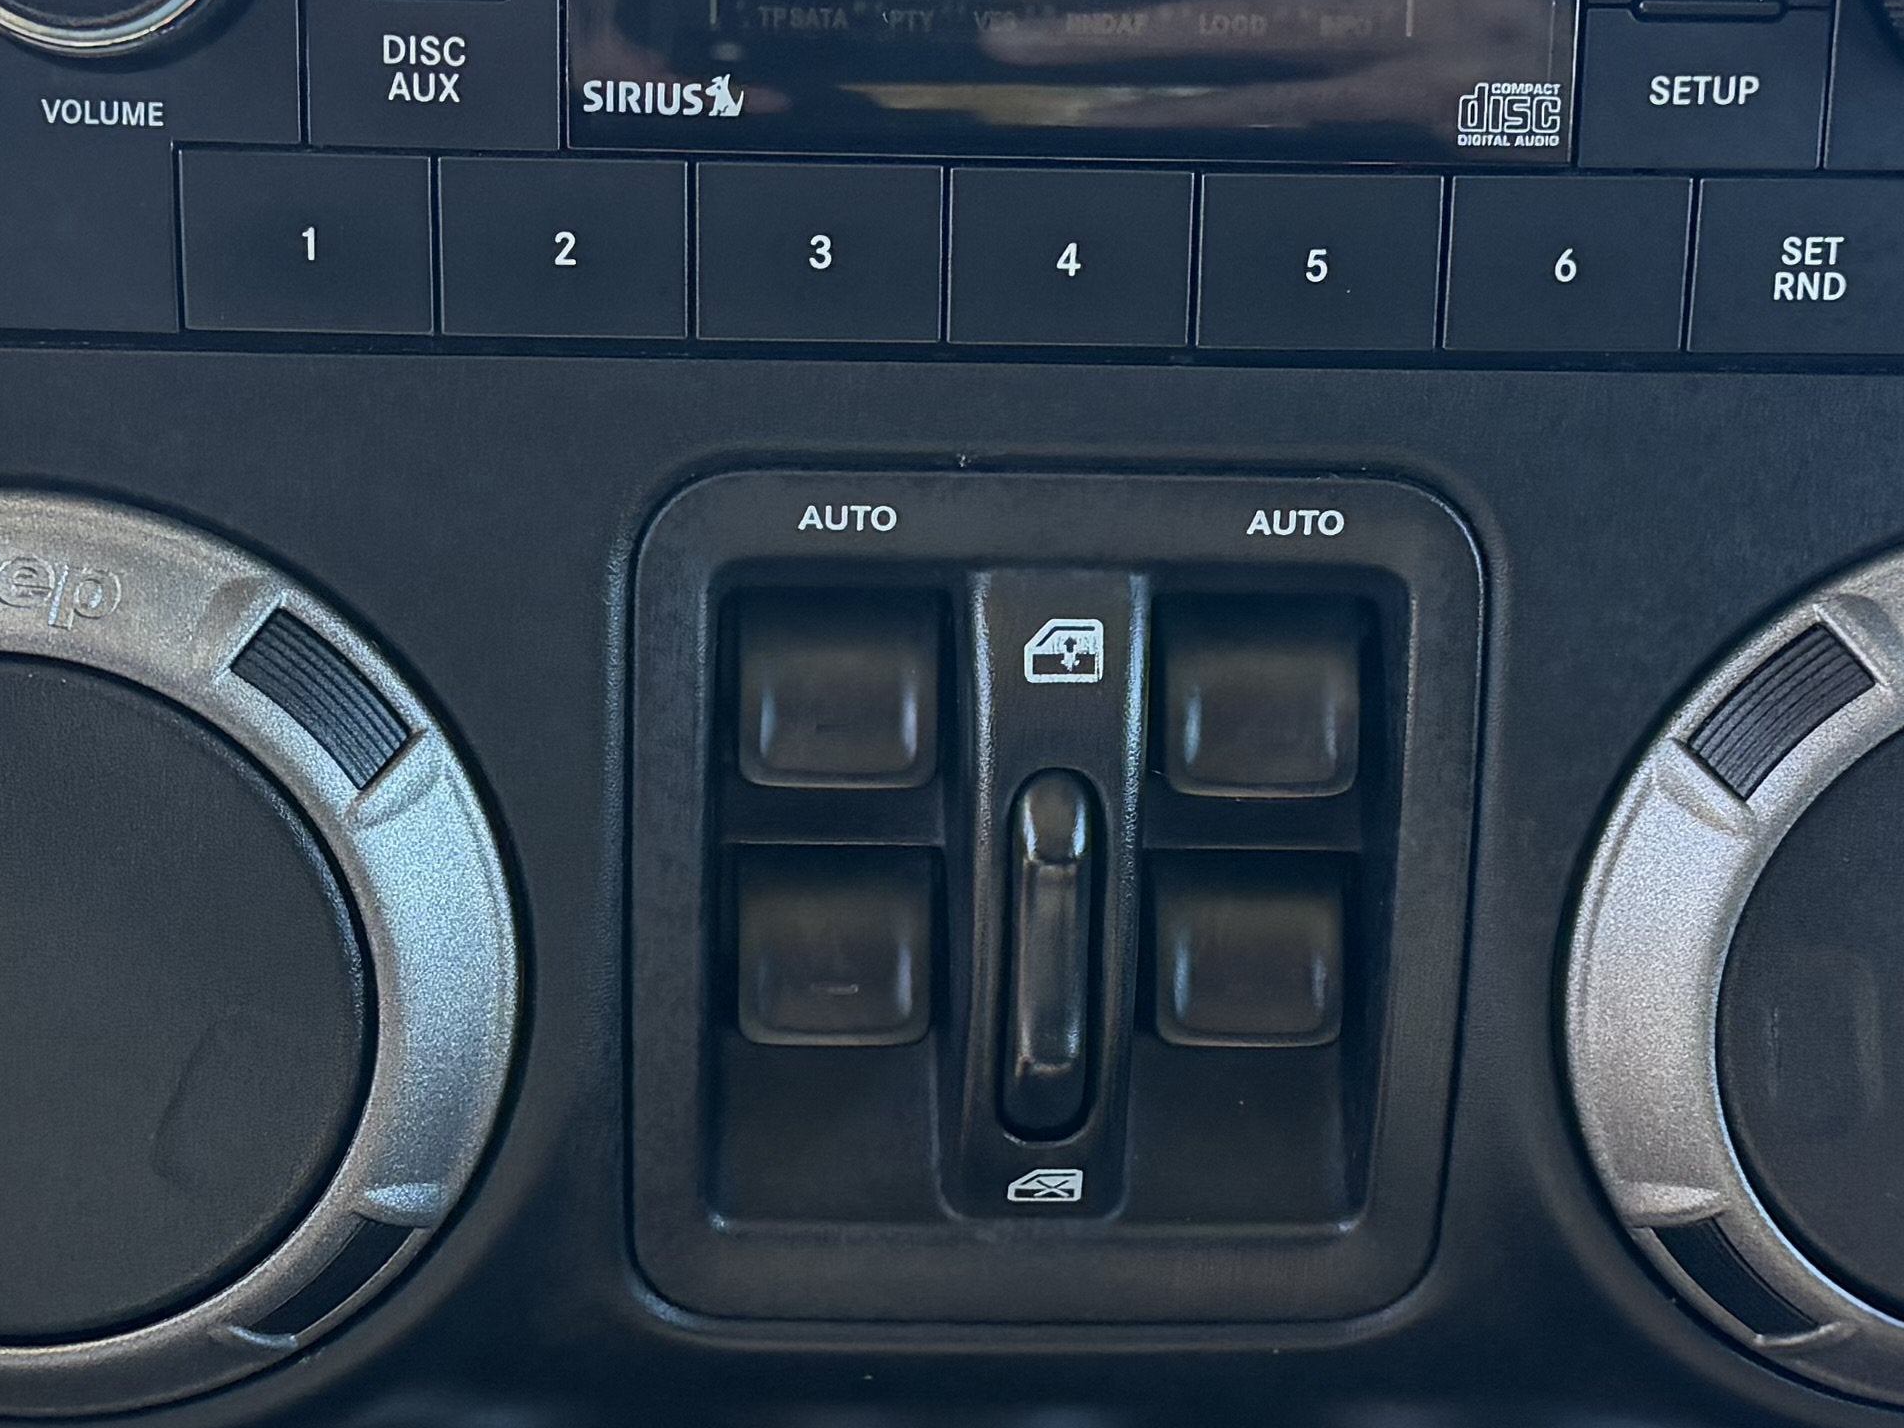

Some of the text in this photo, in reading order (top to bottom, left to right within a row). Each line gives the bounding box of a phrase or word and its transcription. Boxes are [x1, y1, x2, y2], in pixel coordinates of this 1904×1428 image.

[384, 35, 465, 66] DISC
[389, 72, 459, 102] AUX
[583, 80, 702, 116] SIRIUS
[1491, 83, 1561, 96] COMPACT
[1650, 76, 1759, 105] SETUP
[41, 99, 163, 126] VOLUME
[1457, 134, 1560, 148] DIGITAL AUDIO
[302, 227, 314, 260] 1
[555, 232, 576, 265] 2
[809, 235, 831, 269] 3
[1782, 237, 1844, 265] SET
[1057, 243, 1081, 276] 4
[1306, 249, 1327, 282] 5
[1555, 249, 1576, 282] 6
[1774, 272, 1846, 300] RND
[798, 506, 896, 531] AUTO
[1247, 510, 1344, 535] AUTO
